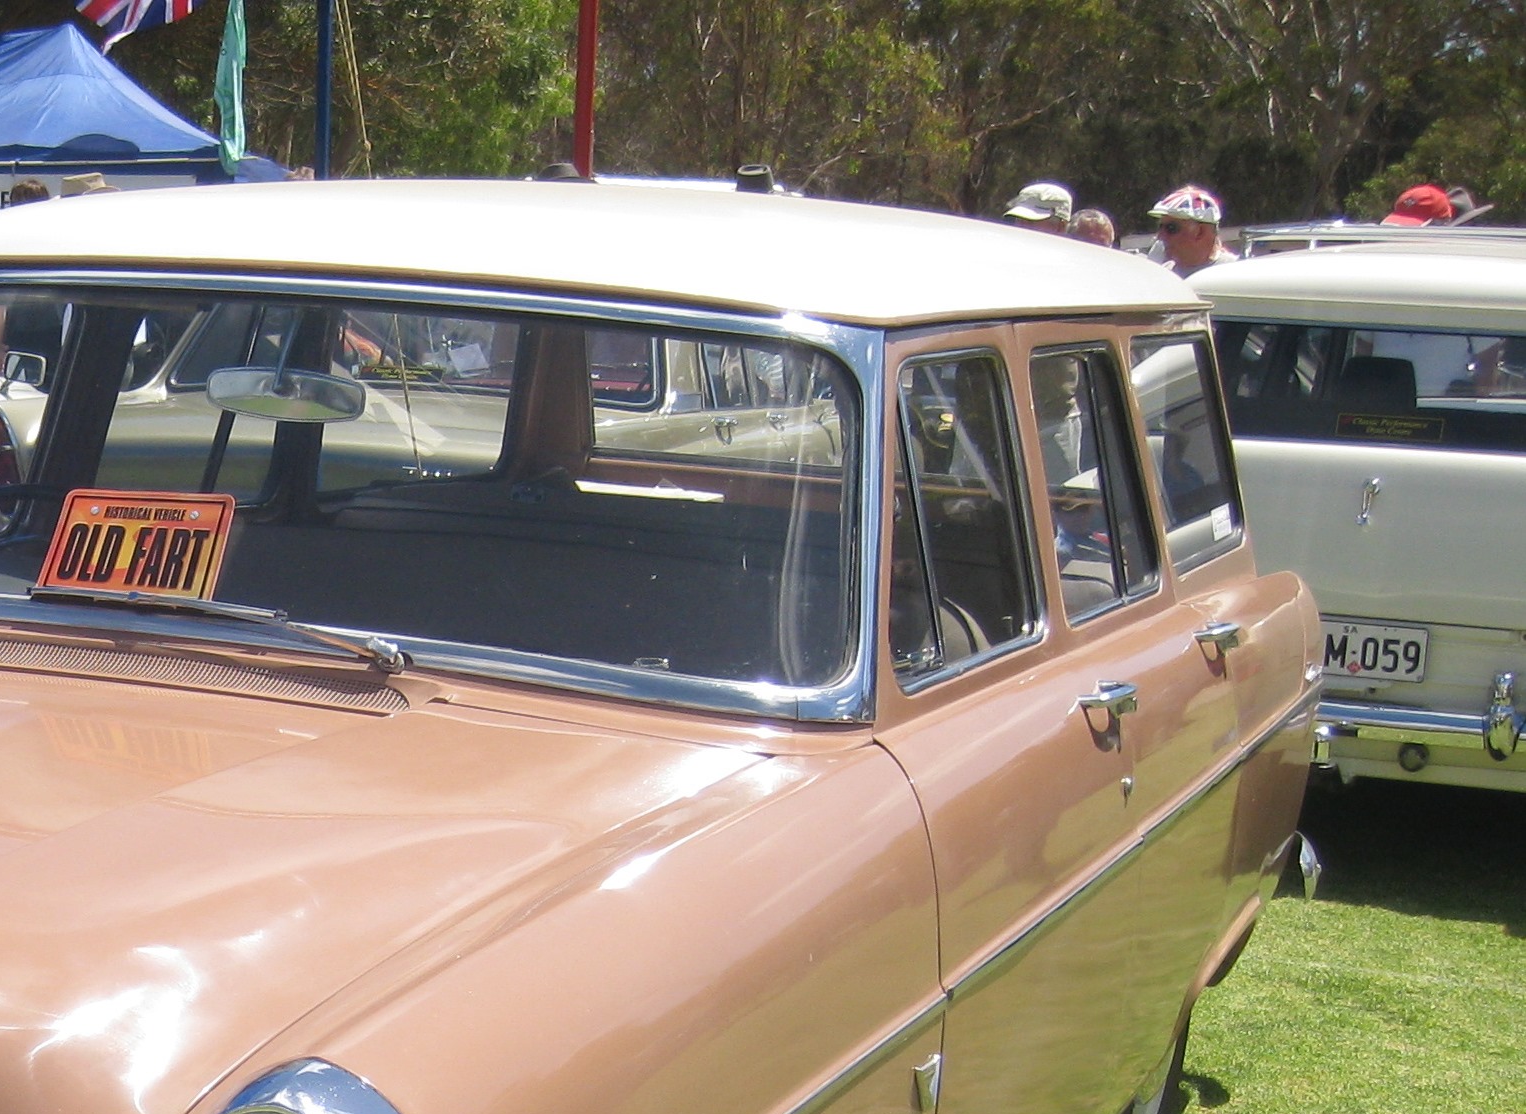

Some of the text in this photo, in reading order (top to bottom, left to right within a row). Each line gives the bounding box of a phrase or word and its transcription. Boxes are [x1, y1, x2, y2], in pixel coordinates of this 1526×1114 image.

[104, 505, 187, 522] HISTORICAL VEHICLE
[57, 522, 211, 591] OLD FART
